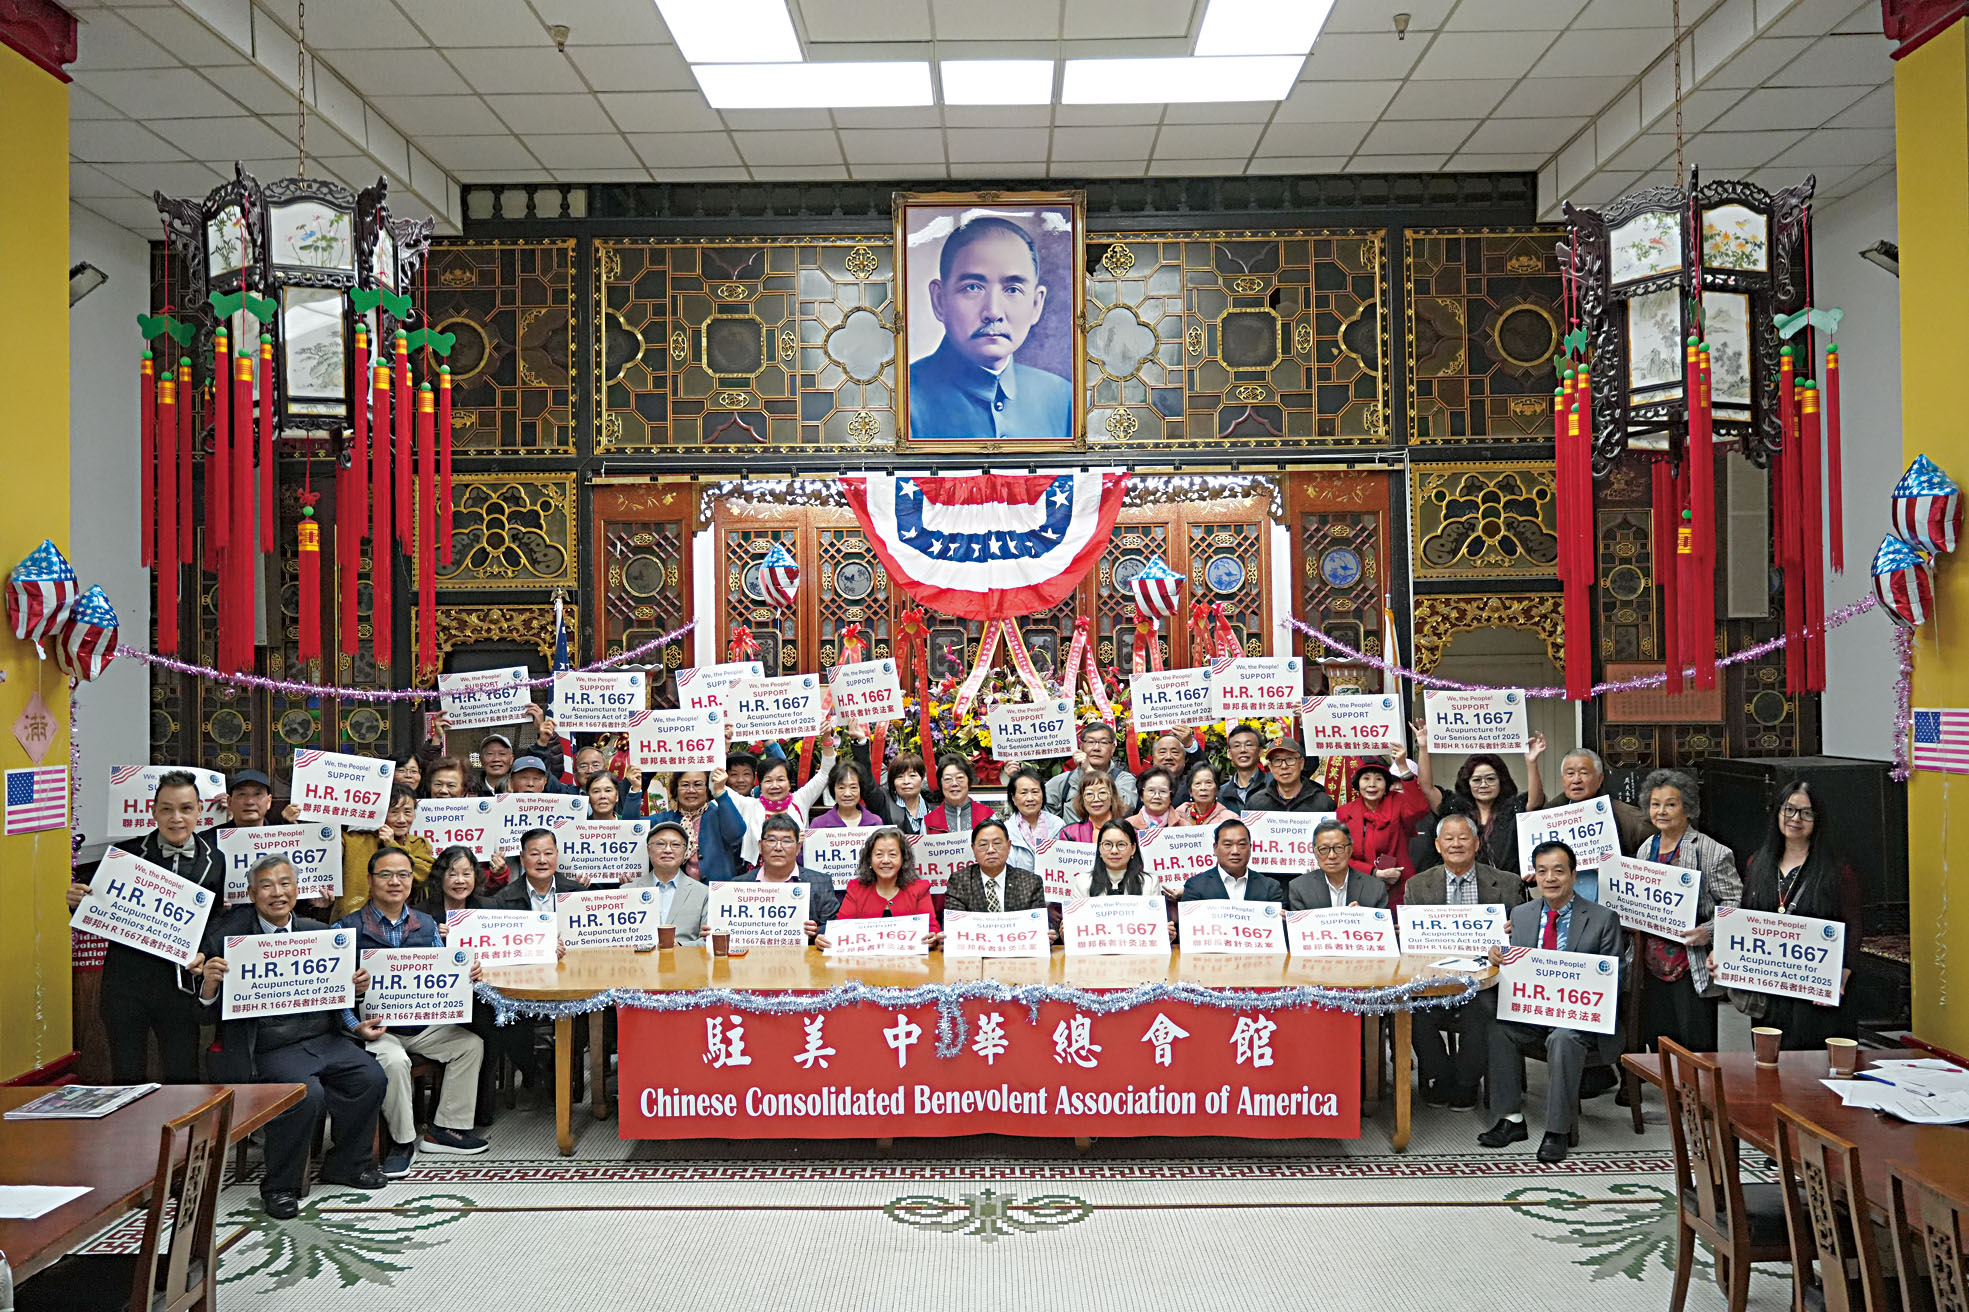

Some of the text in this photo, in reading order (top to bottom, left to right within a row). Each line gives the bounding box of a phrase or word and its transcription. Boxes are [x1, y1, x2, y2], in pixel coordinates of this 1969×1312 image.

[846, 677, 874, 687] SUPPORT
[1156, 681, 1189, 690] SUPPORT
[565, 692, 635, 705] H.R. 1667
[753, 689, 787, 698] SUPPORT
[837, 688, 891, 707] H.R. 1667
[1142, 687, 1209, 704] H.R. 1667
[1223, 686, 1294, 698] H.R. 1667
[459, 702, 502, 711] Acupuncture
[691, 695, 722, 709] H.R.
[739, 696, 809, 712] H.R. 1667
[1011, 714, 1043, 722] SUPPORT
[1332, 711, 1369, 719] SUPPORT
[1437, 711, 1513, 725] H.R. 1667
[657, 725, 695, 733] SUPPORT
[999, 719, 1064, 735] H.R. 1667
[1315, 725, 1389, 738] H.R. 1667
[640, 738, 714, 753] H.R. 1667
[328, 771, 365, 782] SUPPORT
[306, 784, 381, 805] H.R. 1667
[425, 815, 464, 823] SUPPORT
[504, 814, 532, 827] H.R.
[1547, 816, 1583, 829] SUPPORT
[444, 828, 484, 842] 1667
[1569, 821, 1604, 840] 1667
[254, 840, 300, 850] SUPPORT
[564, 841, 638, 854] H.R. 1667
[1169, 841, 1202, 850] SUPPORT
[1252, 840, 1283, 853] H.R.
[815, 849, 845, 862] H.R.
[928, 848, 964, 857] SUPPORT
[1058, 857, 1092, 866] SUPPORT
[1153, 857, 1184, 871] H.R.
[135, 863, 184, 890] We, the People!
[1045, 868, 1068, 884] H.R.
[1624, 872, 1661, 886] SUPPORT
[134, 876, 177, 899] SUPPORT
[1610, 878, 1684, 907] H.R. 1667
[106, 879, 195, 925] H.R. 1667
[585, 903, 624, 912] SUPPORT
[110, 901, 181, 933] Acupuncture for
[721, 905, 797, 918] H.R. 1667
[89, 905, 108, 917] Our
[109, 912, 145, 930] Seniors
[146, 925, 161, 936] Act
[172, 935, 190, 949] 2025
[569, 911, 647, 929] H.R. 1667
[1412, 920, 1493, 930] H.R. 1667
[1746, 916, 1807, 930] We, the People!
[958, 931, 1037, 943] H.R. 1667
[1077, 923, 1157, 937] H.R. 1667
[1193, 925, 1272, 939] H.R. 1667
[1302, 930, 1383, 941] H.R. 1667
[1752, 927, 1801, 941] SUPPORT
[289, 937, 317, 945] People!
[460, 934, 545, 948] H.R. 1667
[838, 930, 917, 946] H.R. 1667
[263, 948, 312, 959] SUPPORT
[1730, 935, 1828, 963] H.R. 1667
[241, 957, 340, 980] H.R. 1667
[390, 963, 433, 972] SUPPORT
[1531, 957, 1544, 965] We,
[1559, 960, 1586, 968] People!
[1739, 954, 1818, 973] Acupuncture for
[1536, 968, 1581, 980] SUPPORT
[1723, 962, 1740, 971] Our
[1742, 965, 1779, 977] Seniors
[1781, 971, 1797, 980] Act
[1811, 976, 1832, 987] 2025
[251, 979, 314, 990] Acupuncture
[372, 974, 459, 990] H.R. 1667
[254, 991, 291, 1000] Seniors
[293, 988, 309, 996] Act
[312, 987, 321, 995] of
[323, 985, 345, 994] 2025
[1513, 982, 1604, 1007] H.R. 1667
[702, 1013, 1278, 1069] 駐美中華總會館
[640, 1084, 1339, 1117] Chinese Consolidated Benevolent Association of America
